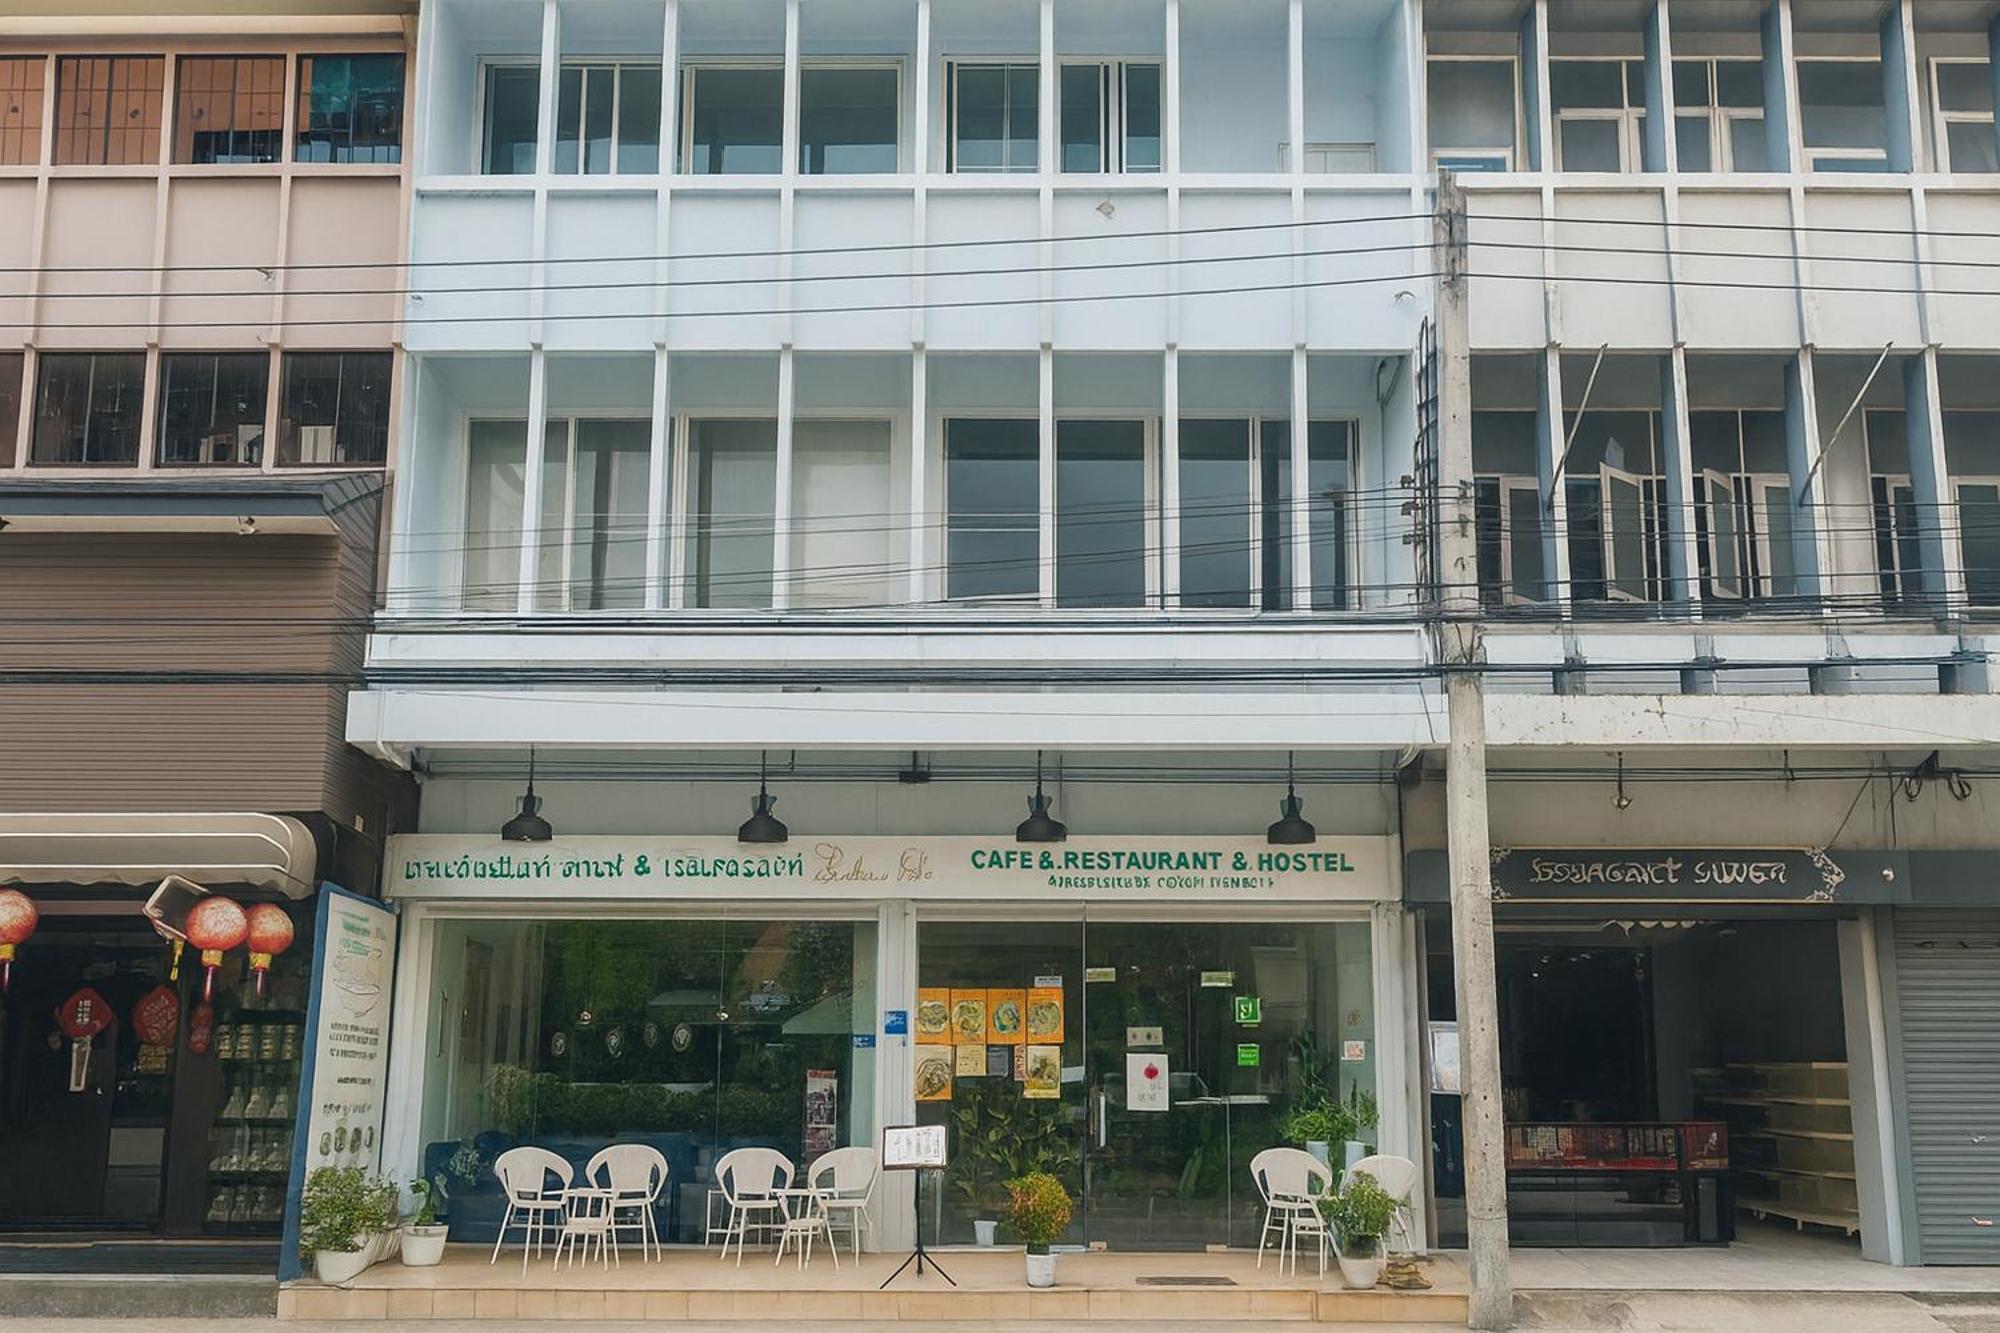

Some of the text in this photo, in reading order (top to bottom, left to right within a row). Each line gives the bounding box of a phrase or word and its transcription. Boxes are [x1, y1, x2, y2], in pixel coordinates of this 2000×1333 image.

[971, 849, 1033, 870] CAFE
[1064, 850, 1223, 871] RESTAURANT
[1258, 852, 1354, 872] HOSTEL
